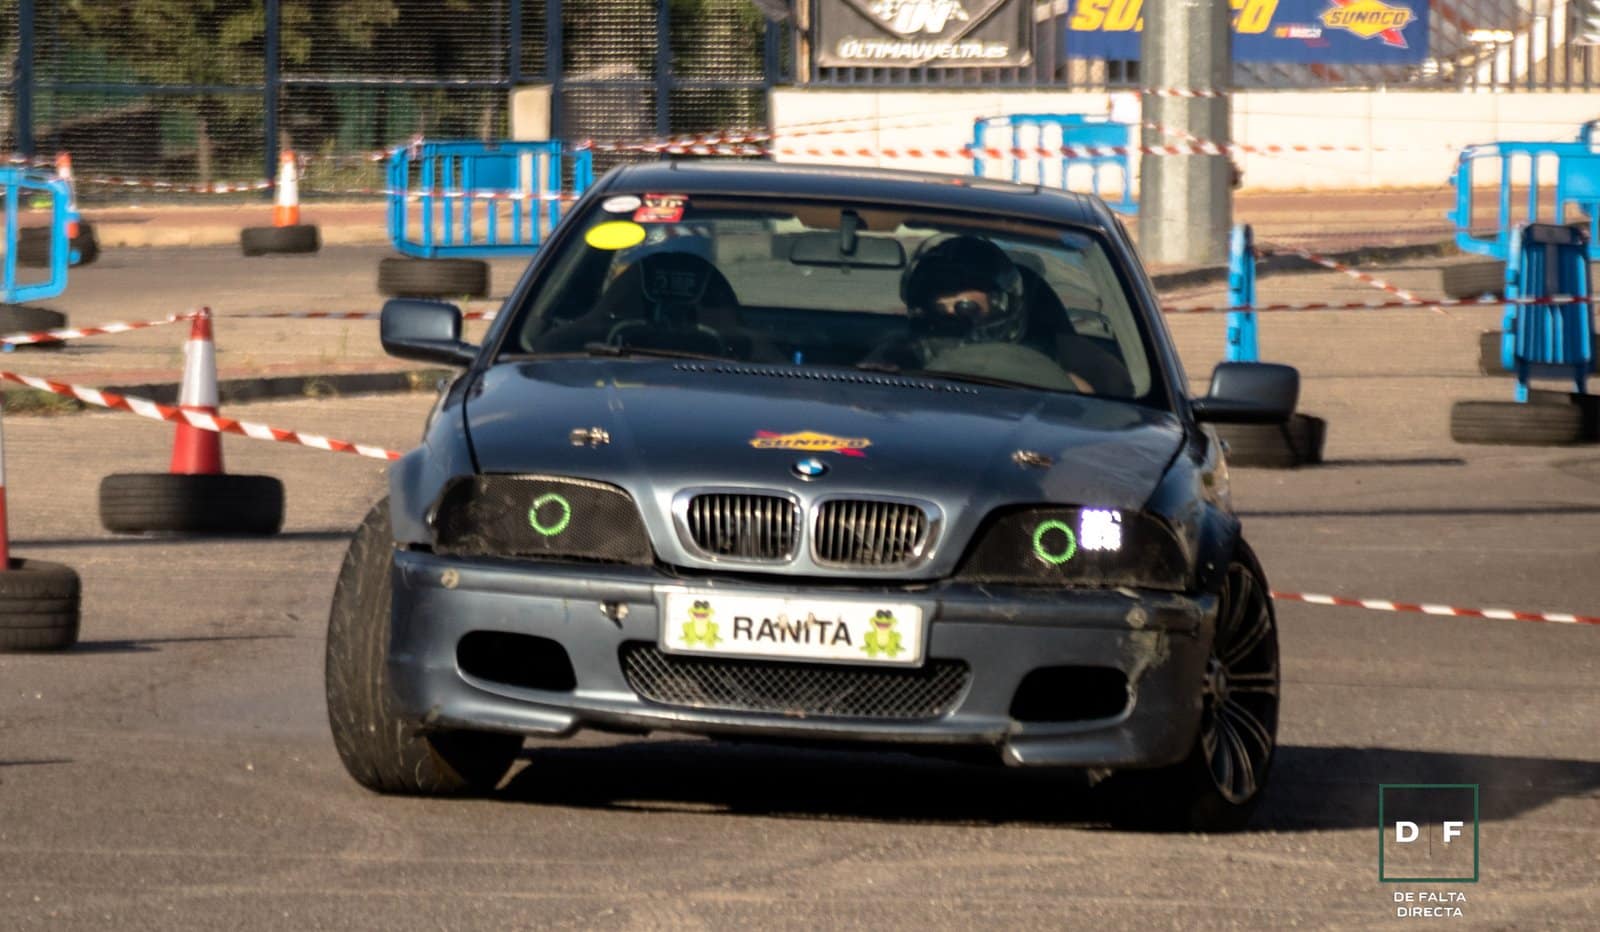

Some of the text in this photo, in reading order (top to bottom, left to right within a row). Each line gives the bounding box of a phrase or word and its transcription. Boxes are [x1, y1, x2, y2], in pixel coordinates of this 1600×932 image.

[1329, 11, 1407, 26] SUNOCO
[758, 438, 866, 448] SUNOCO
[733, 616, 852, 646] RANITA
